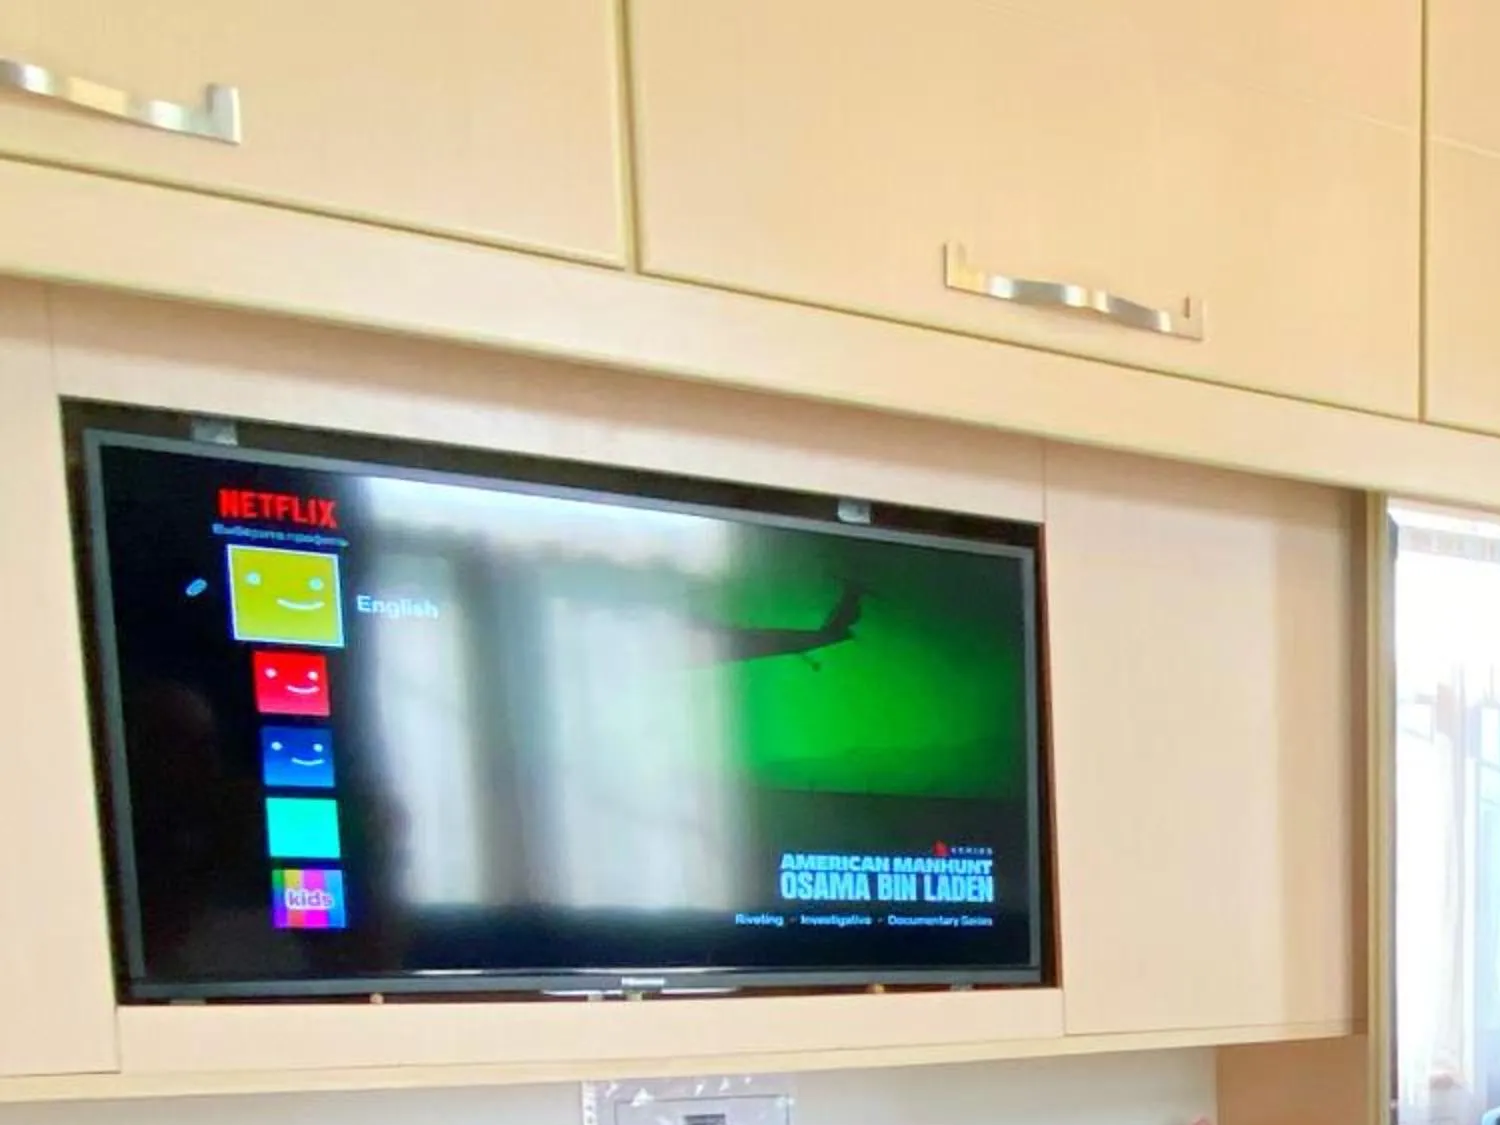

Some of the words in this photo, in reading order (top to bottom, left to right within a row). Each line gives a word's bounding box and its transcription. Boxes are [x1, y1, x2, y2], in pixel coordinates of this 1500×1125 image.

[219, 488, 338, 529] NETFLIX
[356, 594, 439, 620] English
[780, 853, 890, 872] AMERICAN
[893, 856, 993, 874] MANHUNT
[780, 871, 872, 901] OSAMA
[877, 873, 918, 901] BIN
[923, 874, 994, 903] LADEN
[288, 890, 334, 908] kids
[735, 913, 784, 928] Riveting
[800, 914, 872, 928] Investigative
[887, 914, 959, 928] Documentary
[960, 915, 993, 927] Series
